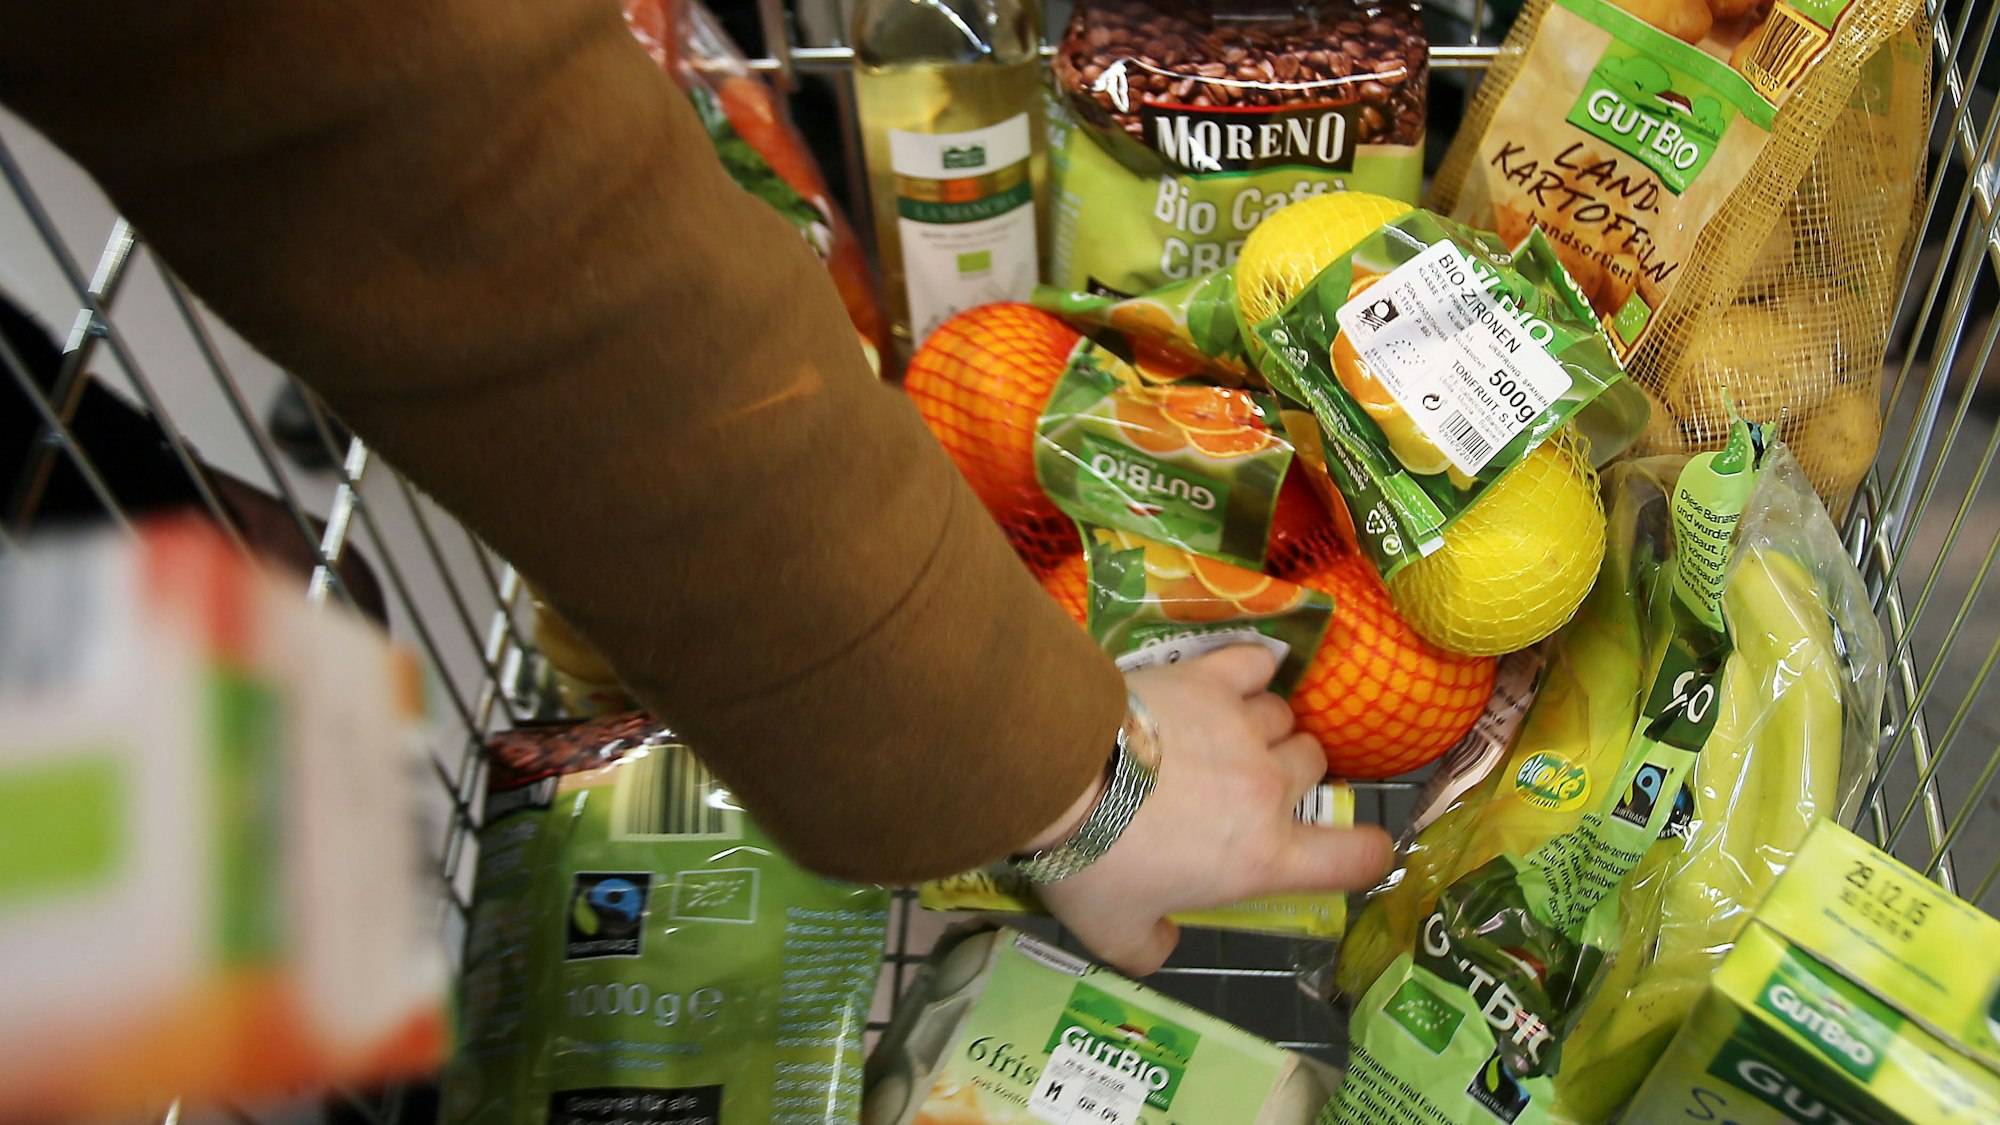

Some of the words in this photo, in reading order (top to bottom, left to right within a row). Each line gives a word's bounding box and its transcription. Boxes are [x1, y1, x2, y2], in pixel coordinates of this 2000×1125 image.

[1155, 112, 1346, 168] MORENO
[1586, 88, 1699, 171] GUTBIO
[1155, 175, 1217, 235] Bio
[1526, 211, 1635, 285] handsortiert
[1489, 369, 1536, 424] 500g
[1522, 377, 1549, 407] SPANIEN
[1499, 408, 1515, 435] S.L.
[1092, 453, 1216, 511] GUTBIO
[1376, 500, 1398, 530] OTHER
[1676, 504, 1693, 523] und
[566, 982, 650, 1018] 1000
[1765, 982, 1875, 1071] GUTBIO
[968, 1036, 995, 1061] 6
[988, 1042, 1040, 1086] fris
[1060, 1025, 1170, 1092] GUTBIO
[1044, 1079, 1065, 1101] M
